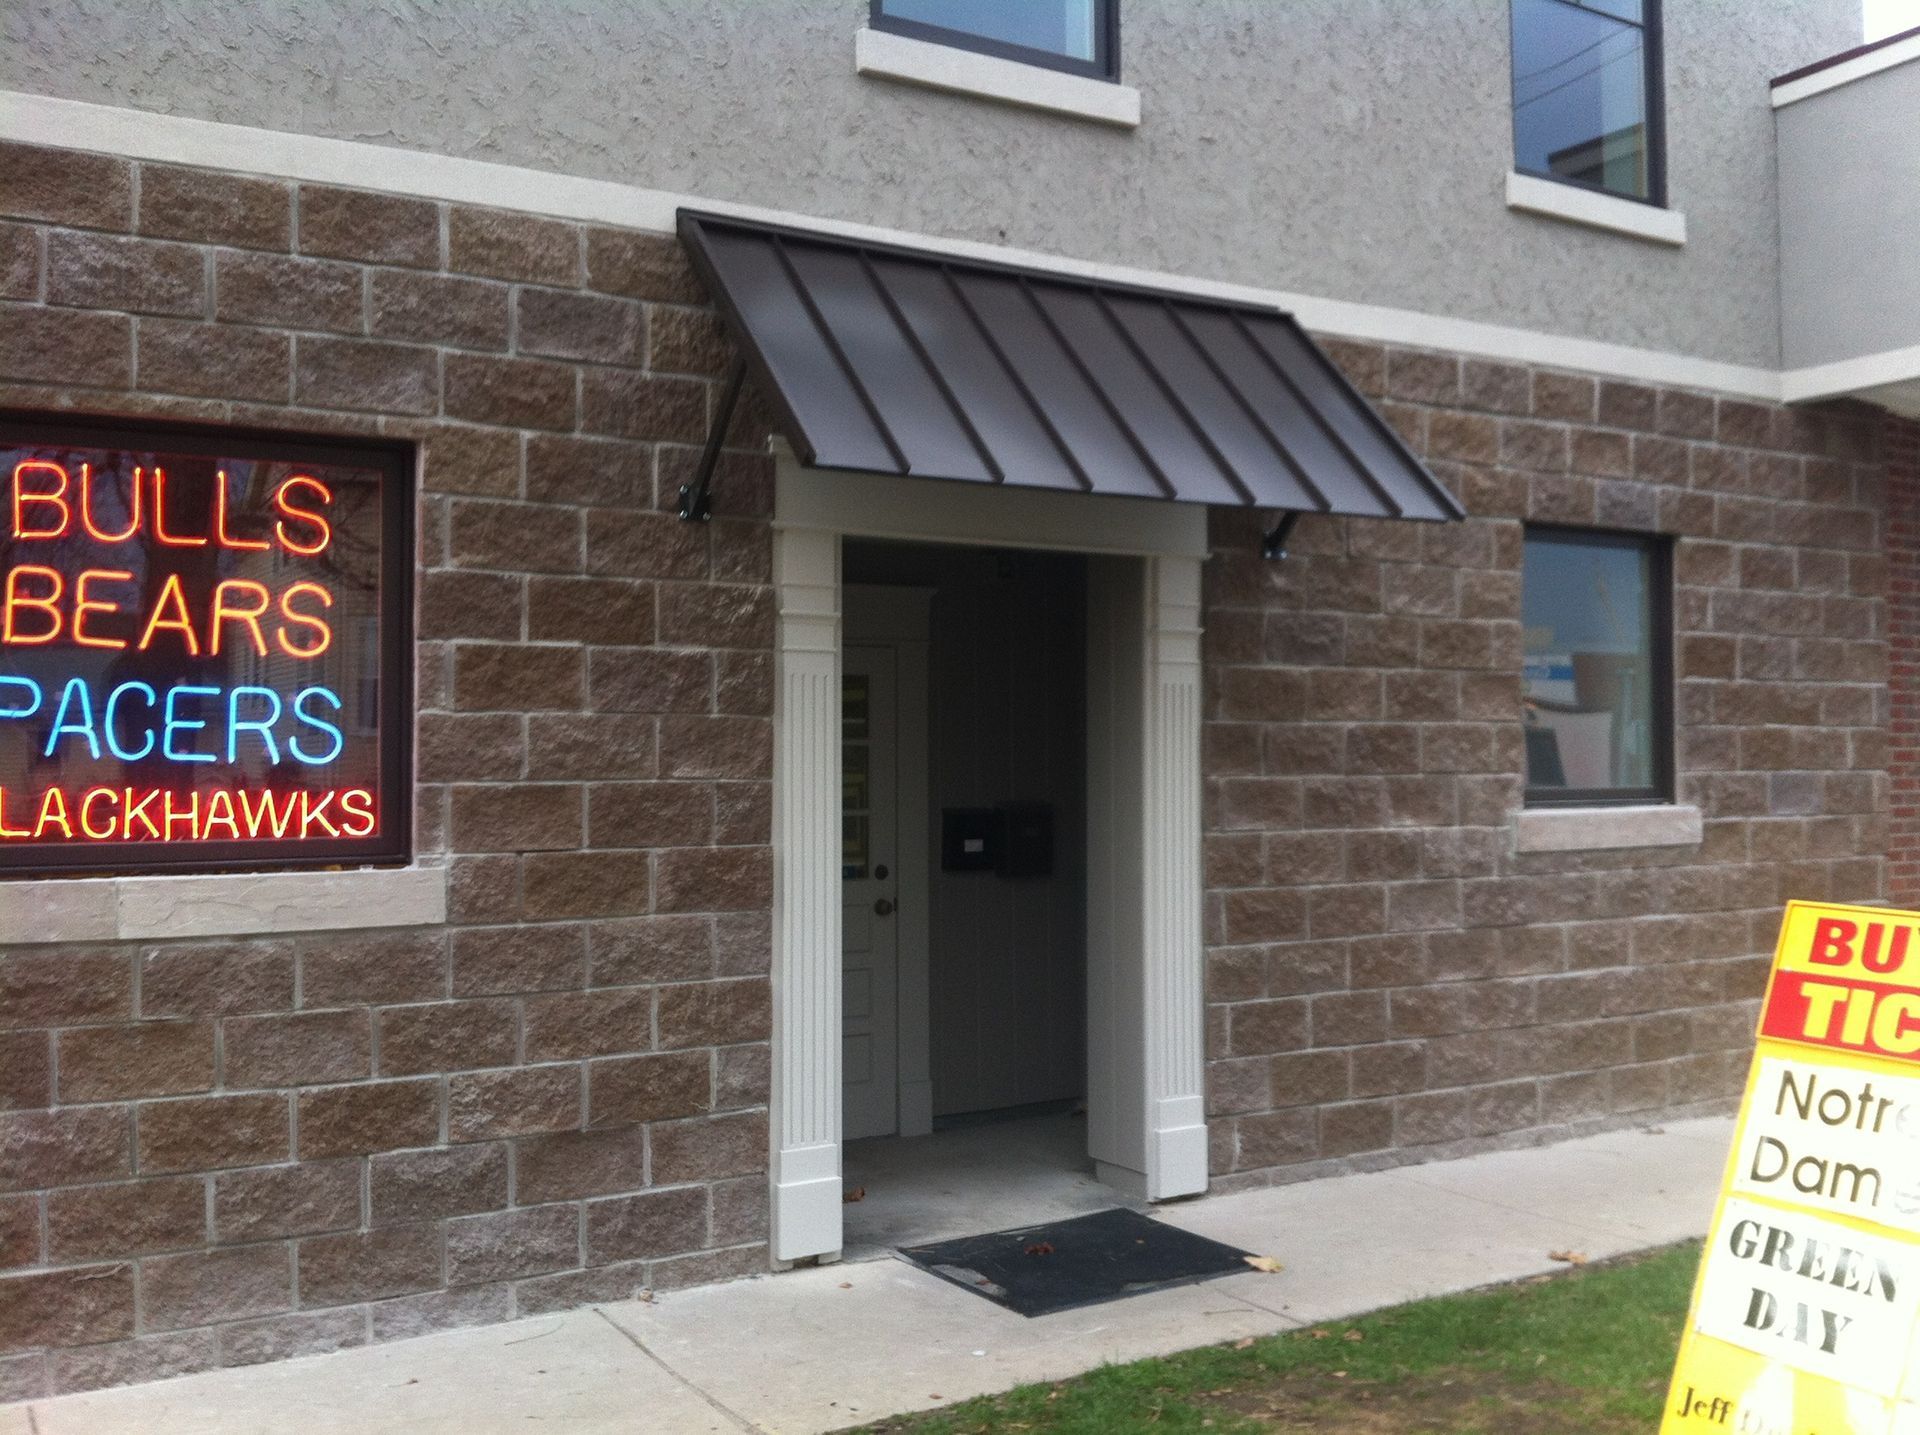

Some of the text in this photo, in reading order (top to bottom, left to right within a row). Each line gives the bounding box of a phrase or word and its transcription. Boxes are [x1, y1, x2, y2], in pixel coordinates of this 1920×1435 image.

[12, 459, 333, 556] BULLS
[1, 565, 333, 659] BEARS
[0, 676, 344, 766] PACERS
[1808, 917, 1920, 975] BU
[1729, 1219, 1899, 1303] GREEN
[1743, 1287, 1853, 1354] DAY
[1677, 1386, 1734, 1424] Jeff
